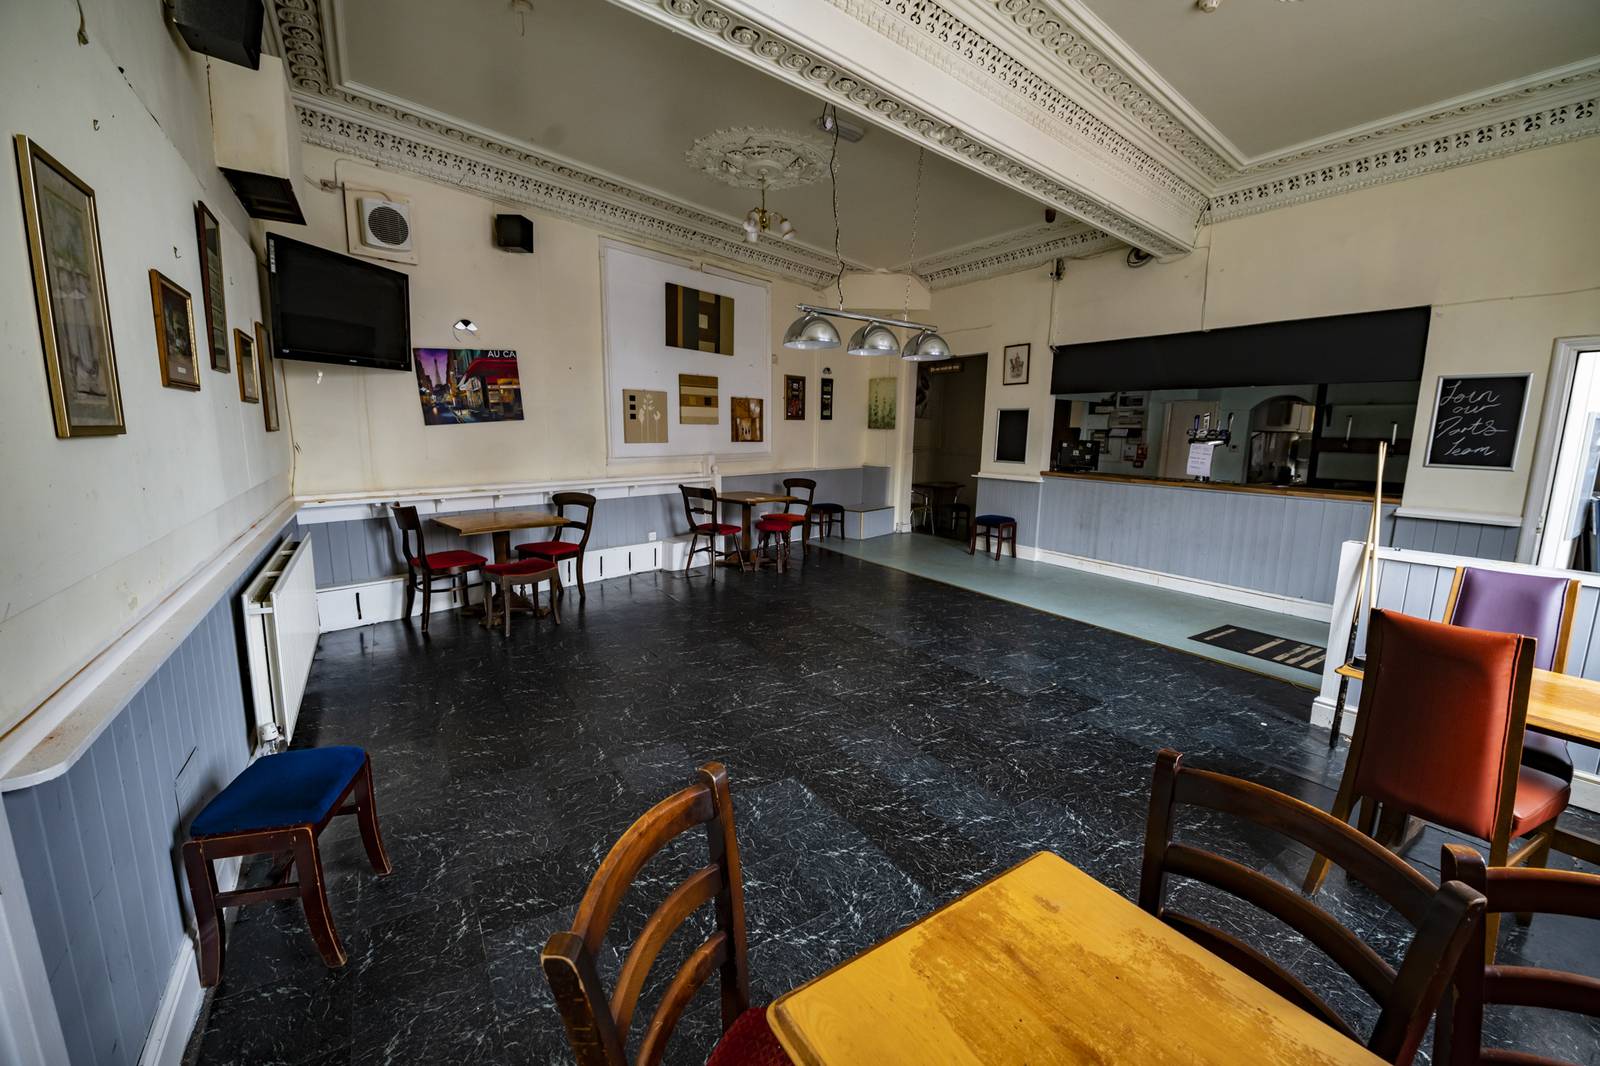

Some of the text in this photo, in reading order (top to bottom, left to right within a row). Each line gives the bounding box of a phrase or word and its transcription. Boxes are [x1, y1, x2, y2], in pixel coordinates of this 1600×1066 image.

[487, 350, 500, 358] AU
[1440, 380, 1500, 406] Join
[1452, 403, 1502, 414] our
[1435, 415, 1509, 439] Darts
[1443, 436, 1497, 456] Team
